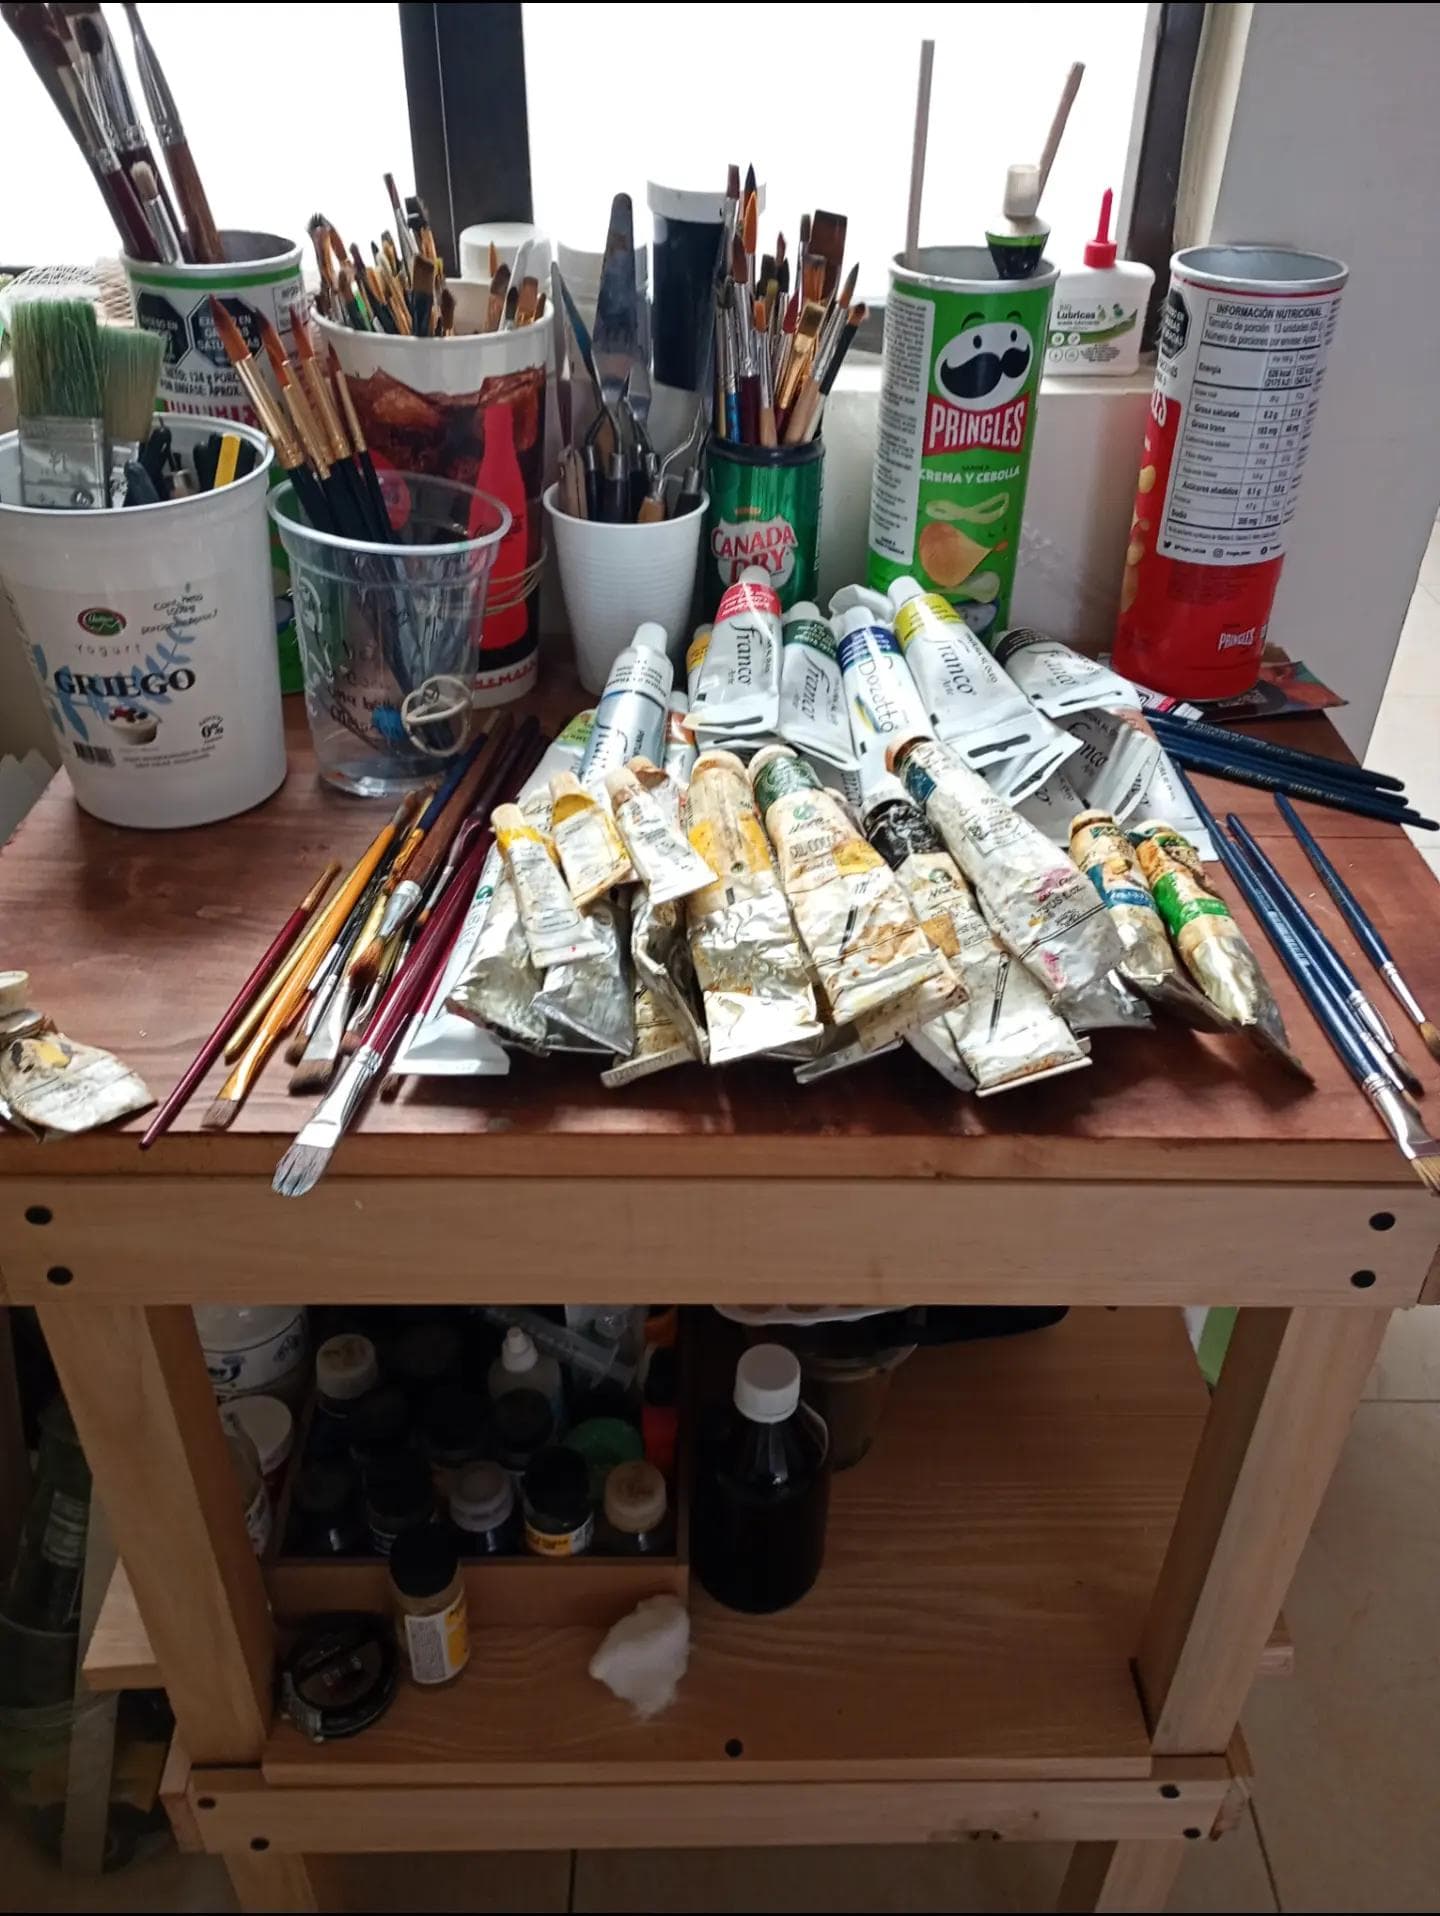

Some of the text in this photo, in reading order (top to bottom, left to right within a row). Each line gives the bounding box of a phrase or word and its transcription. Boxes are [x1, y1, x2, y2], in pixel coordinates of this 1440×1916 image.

[1216, 303, 1323, 319] INFORMACIÓN NUTRICIONAL
[929, 400, 1026, 450] PRINGLES
[920, 467, 962, 485] CREMA
[965, 468, 976, 485] Y
[976, 466, 1021, 484] CEBOLLA
[711, 525, 796, 557] CANADA
[729, 622, 763, 686] Franco
[1218, 627, 1256, 651] PRINGLES
[54, 667, 196, 698] GRIEGO
